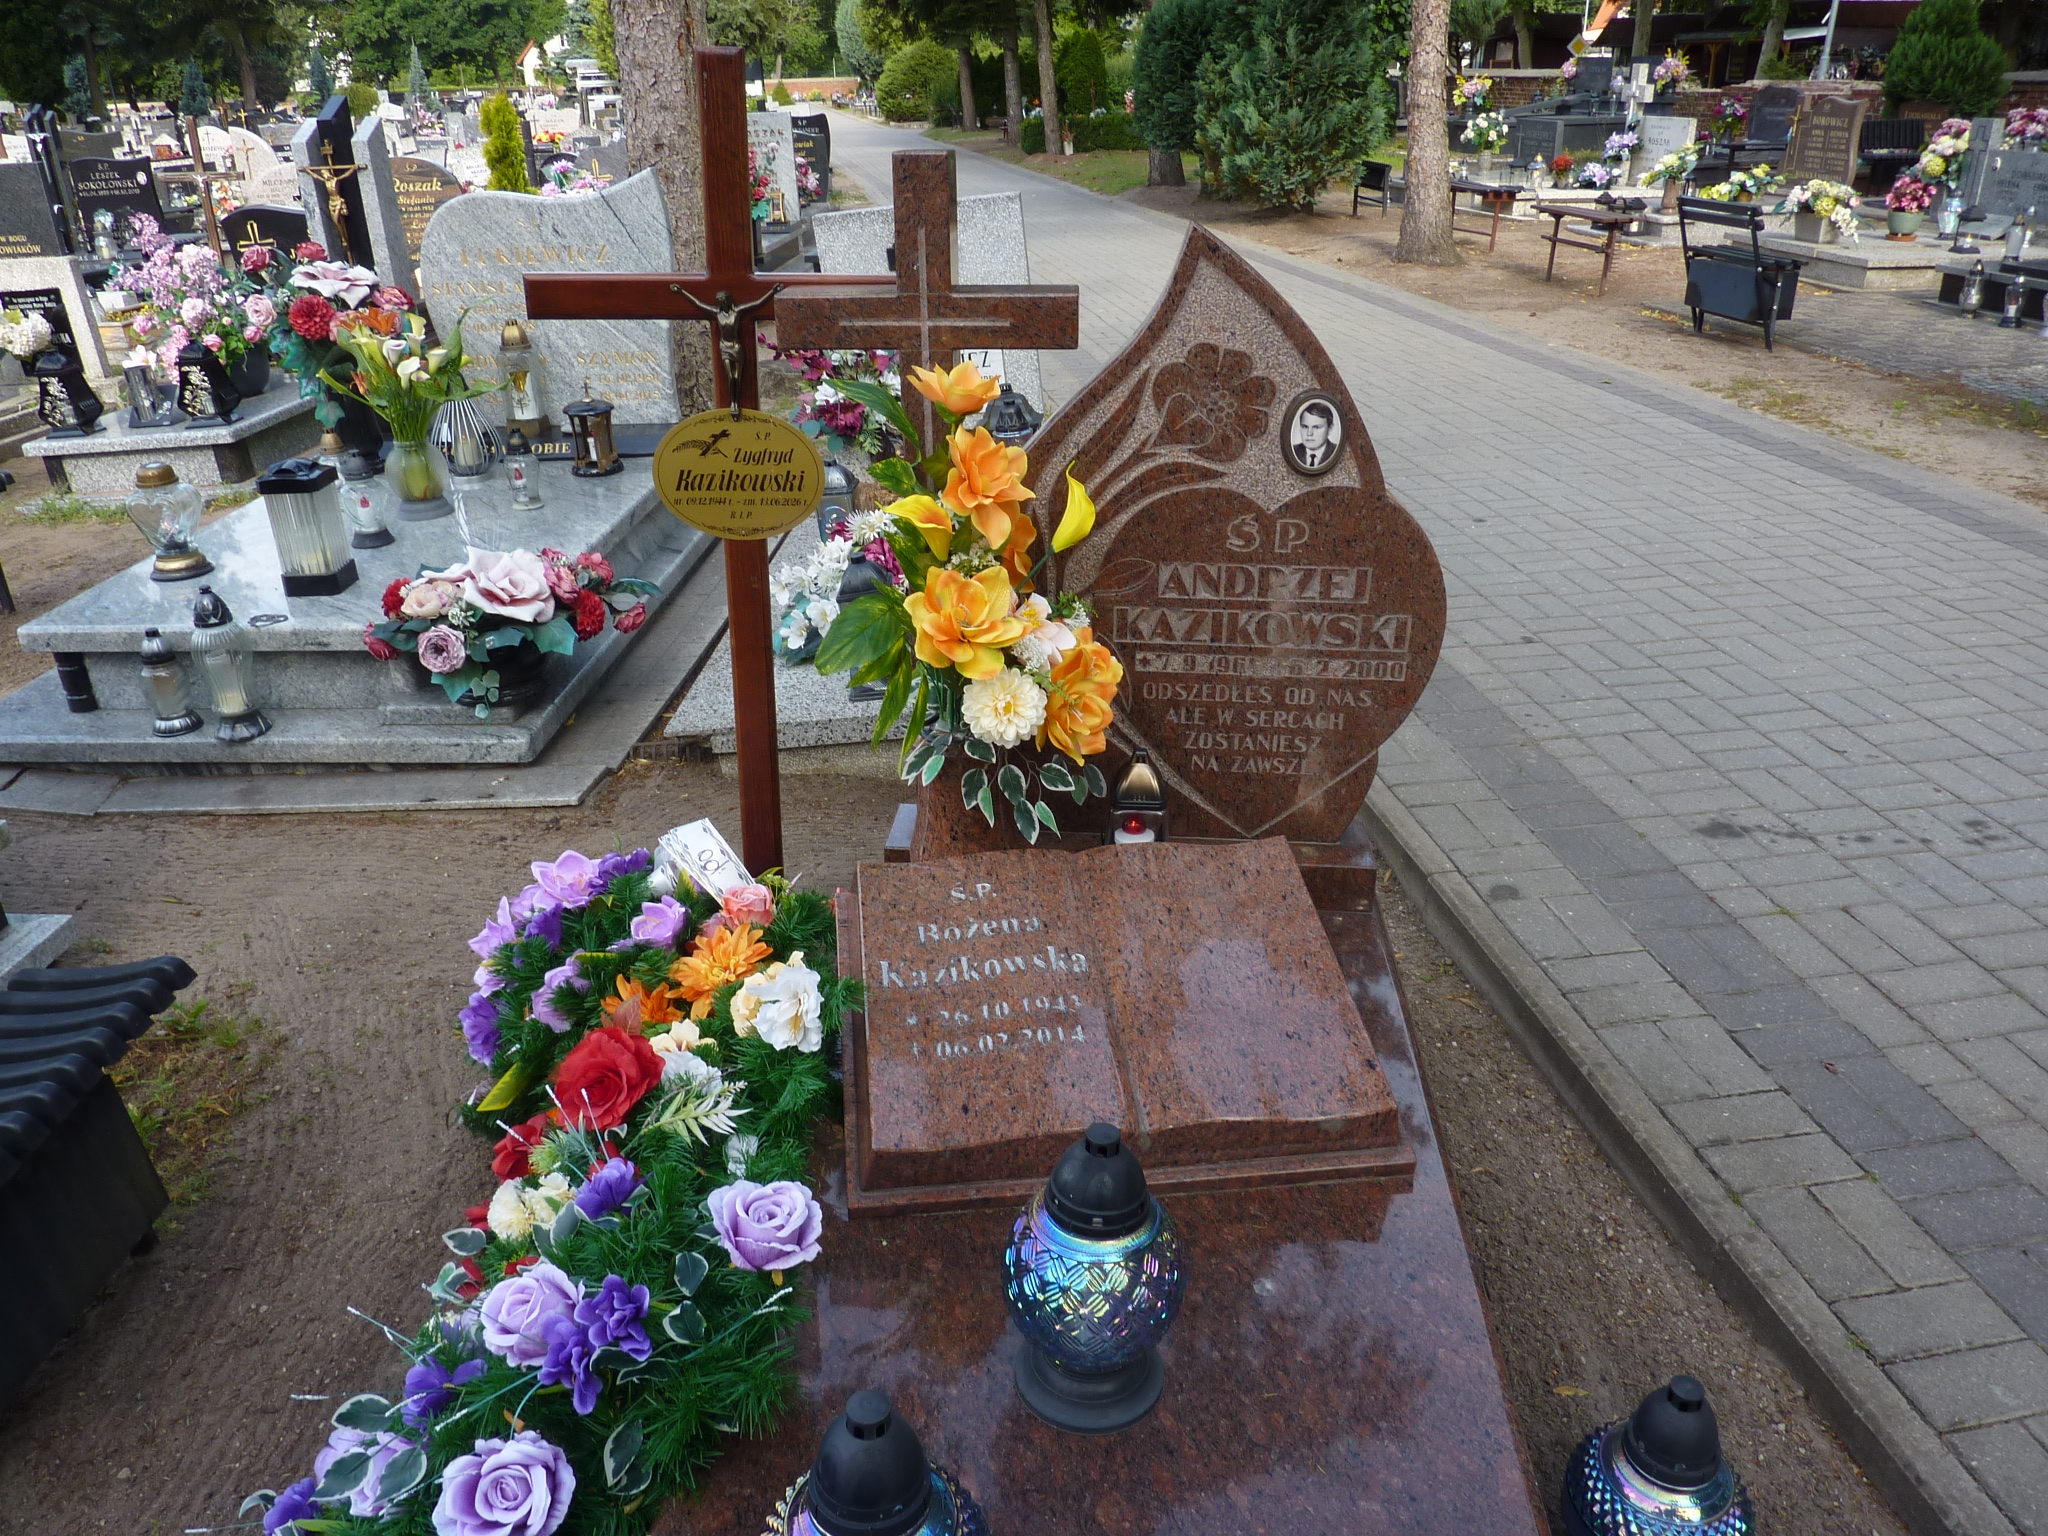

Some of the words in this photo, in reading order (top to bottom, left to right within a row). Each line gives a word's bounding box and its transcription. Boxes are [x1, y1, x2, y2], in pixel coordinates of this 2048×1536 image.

[78, 179, 138, 190] SOKOŁOWSKI
[91, 171, 120, 180] LESZEK
[393, 177, 443, 192] Roszak
[397, 195, 435, 206] Stefania
[8, 235, 28, 243] BOGU
[733, 447, 795, 466] Zygfryd
[675, 469, 806, 492] Kazikowski
[1113, 607, 1412, 652] KAZIKOWSKI
[1284, 687, 1316, 705] OD
[1164, 707, 1206, 725] ALE
[1217, 708, 1235, 726] W
[1244, 709, 1345, 731] SERCACH
[1184, 730, 1323, 753] ZOSTANIESZ
[1191, 756, 1219, 773] NA
[917, 915, 1041, 945] Bożena
[878, 945, 1089, 989] Kazikowska
